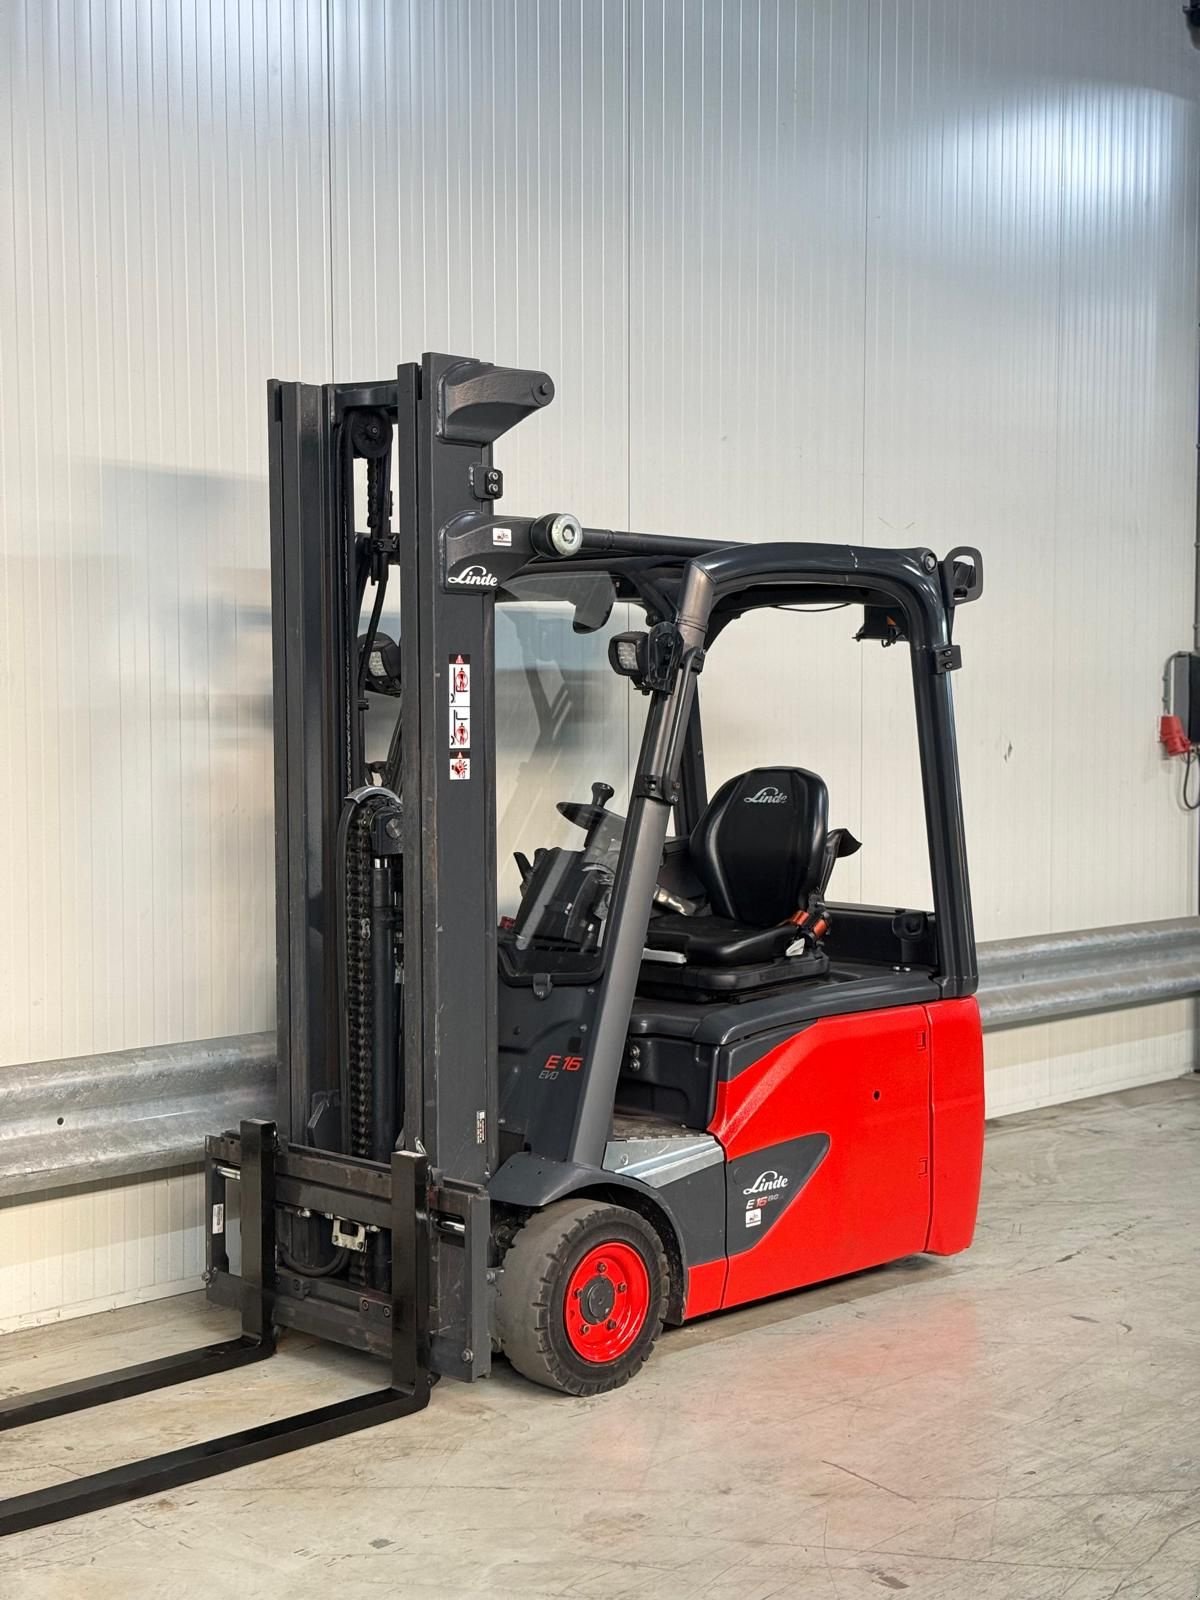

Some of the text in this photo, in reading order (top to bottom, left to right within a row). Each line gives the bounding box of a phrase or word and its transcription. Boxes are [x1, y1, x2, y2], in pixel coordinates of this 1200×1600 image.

[447, 565, 498, 587] Linde
[743, 786, 788, 803] Linde
[538, 1071, 559, 1080] EVO
[742, 1170, 789, 1196] Linde
